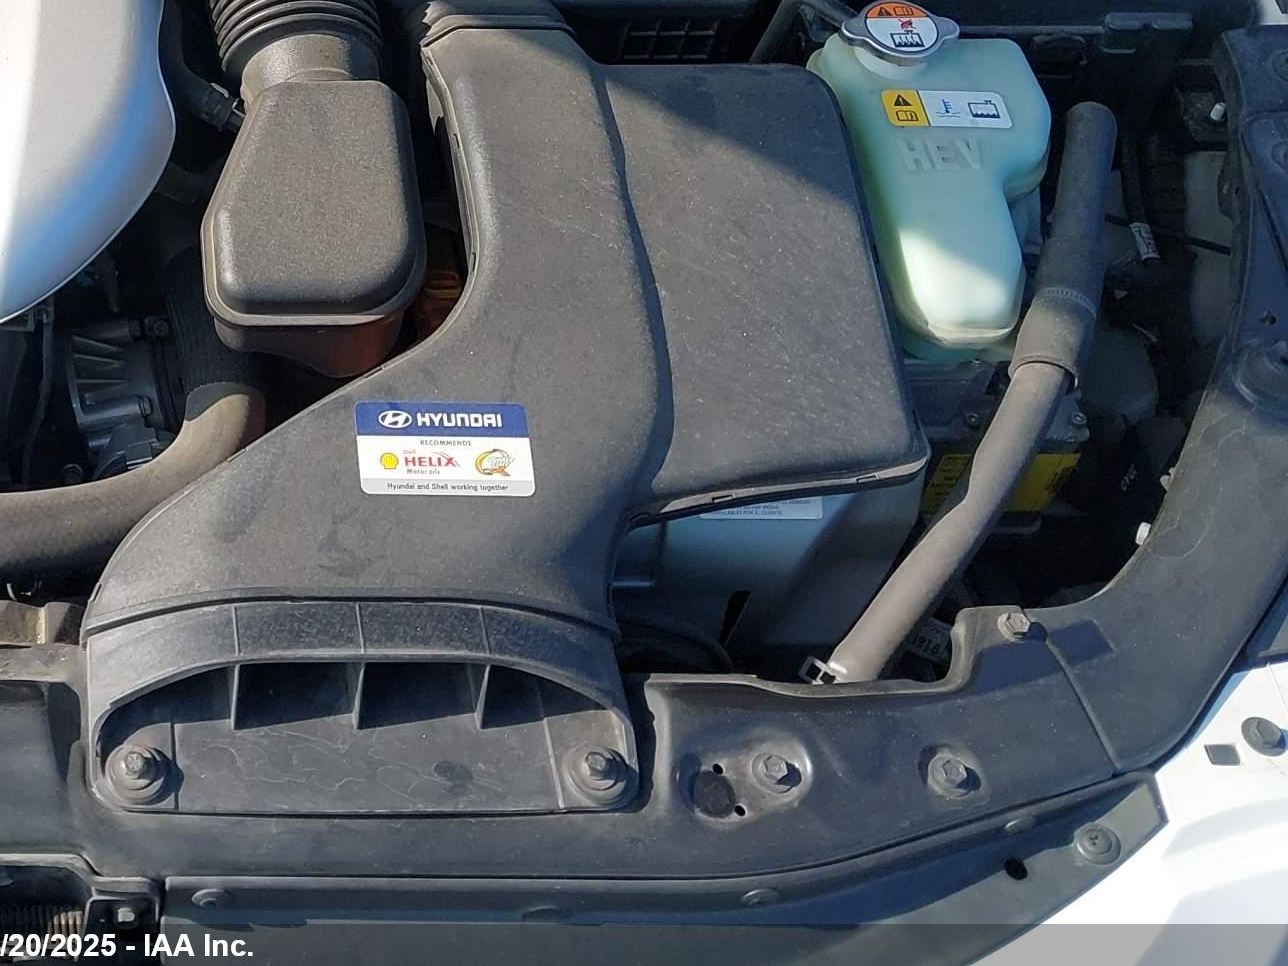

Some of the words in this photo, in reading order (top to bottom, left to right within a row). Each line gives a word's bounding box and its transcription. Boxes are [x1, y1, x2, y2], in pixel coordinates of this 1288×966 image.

[897, 138, 983, 170] HEV
[417, 413, 502, 428] HYUNDAI
[404, 453, 457, 467] HELIX
[387, 483, 415, 491] Hyundai
[451, 483, 478, 492] working
[480, 484, 508, 492] together
